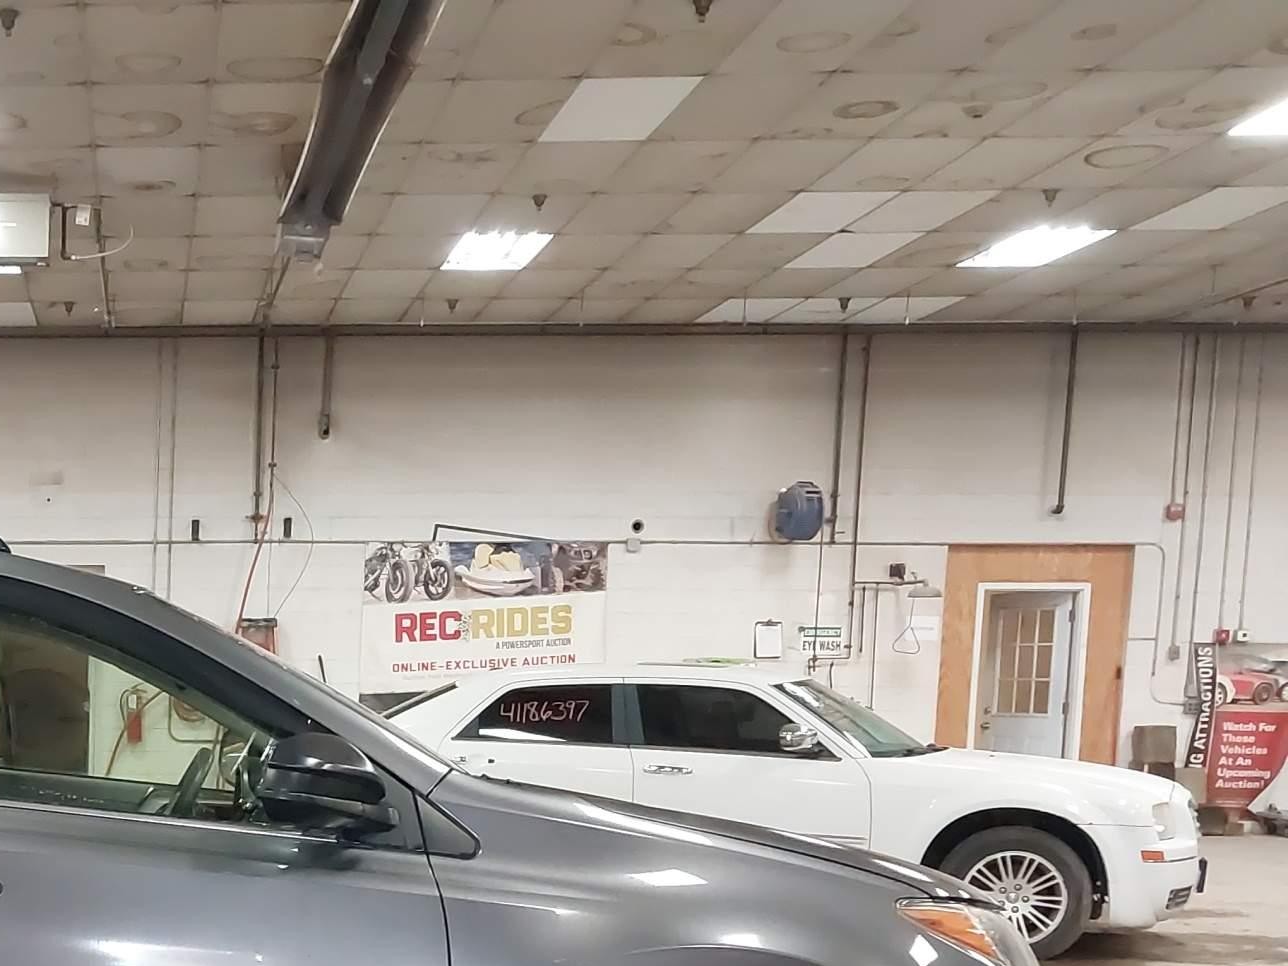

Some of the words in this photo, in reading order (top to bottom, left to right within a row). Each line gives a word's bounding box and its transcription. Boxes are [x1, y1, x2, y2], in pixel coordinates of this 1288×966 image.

[395, 610, 462, 643] REC
[471, 605, 573, 640] RIDES
[495, 641, 501, 650] A
[502, 639, 544, 650] POWERSPORT
[546, 638, 571, 647] AUCTION
[819, 640, 842, 651] WASH
[392, 657, 517, 673] ONLINE-EXCLUSIVE
[522, 654, 576, 666] AUCTION
[1193, 646, 1213, 750] ATTRACTIONS
[1223, 721, 1257, 731] Watch
[1258, 722, 1277, 732] For
[1220, 744, 1268, 755] Vehicles
[1218, 756, 1233, 766] At
[1235, 756, 1253, 766] An
[1216, 767, 1271, 780] Upcoming
[1215, 778, 1264, 789] Auction!
